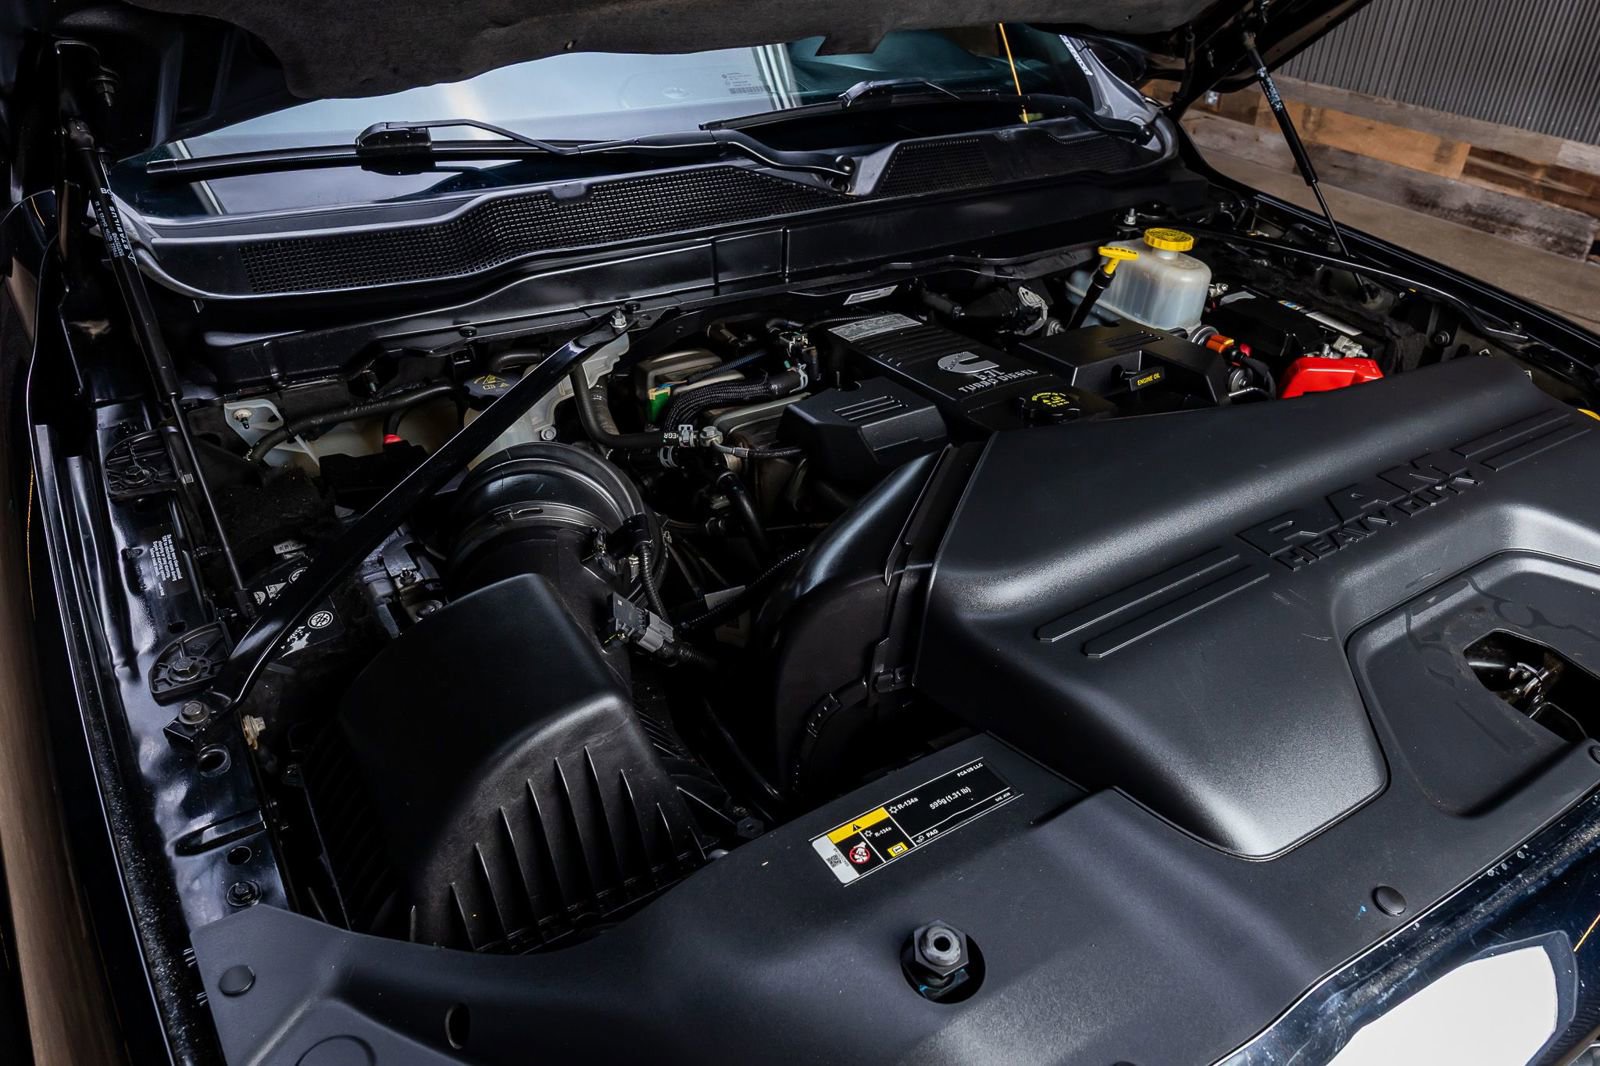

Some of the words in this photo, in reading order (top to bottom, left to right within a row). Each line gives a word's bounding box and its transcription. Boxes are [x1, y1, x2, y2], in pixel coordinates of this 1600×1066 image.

[109, 206, 129, 250] STABILUS
[958, 379, 999, 393] TURBO
[998, 368, 1038, 382] DIESEL
[1137, 375, 1153, 386] ENGINE
[1235, 452, 1470, 557] RAM
[1273, 512, 1398, 571] HEAVY
[1393, 467, 1484, 518] DUTY
[897, 797, 919, 810] R-134a
[926, 828, 939, 838] PAG
